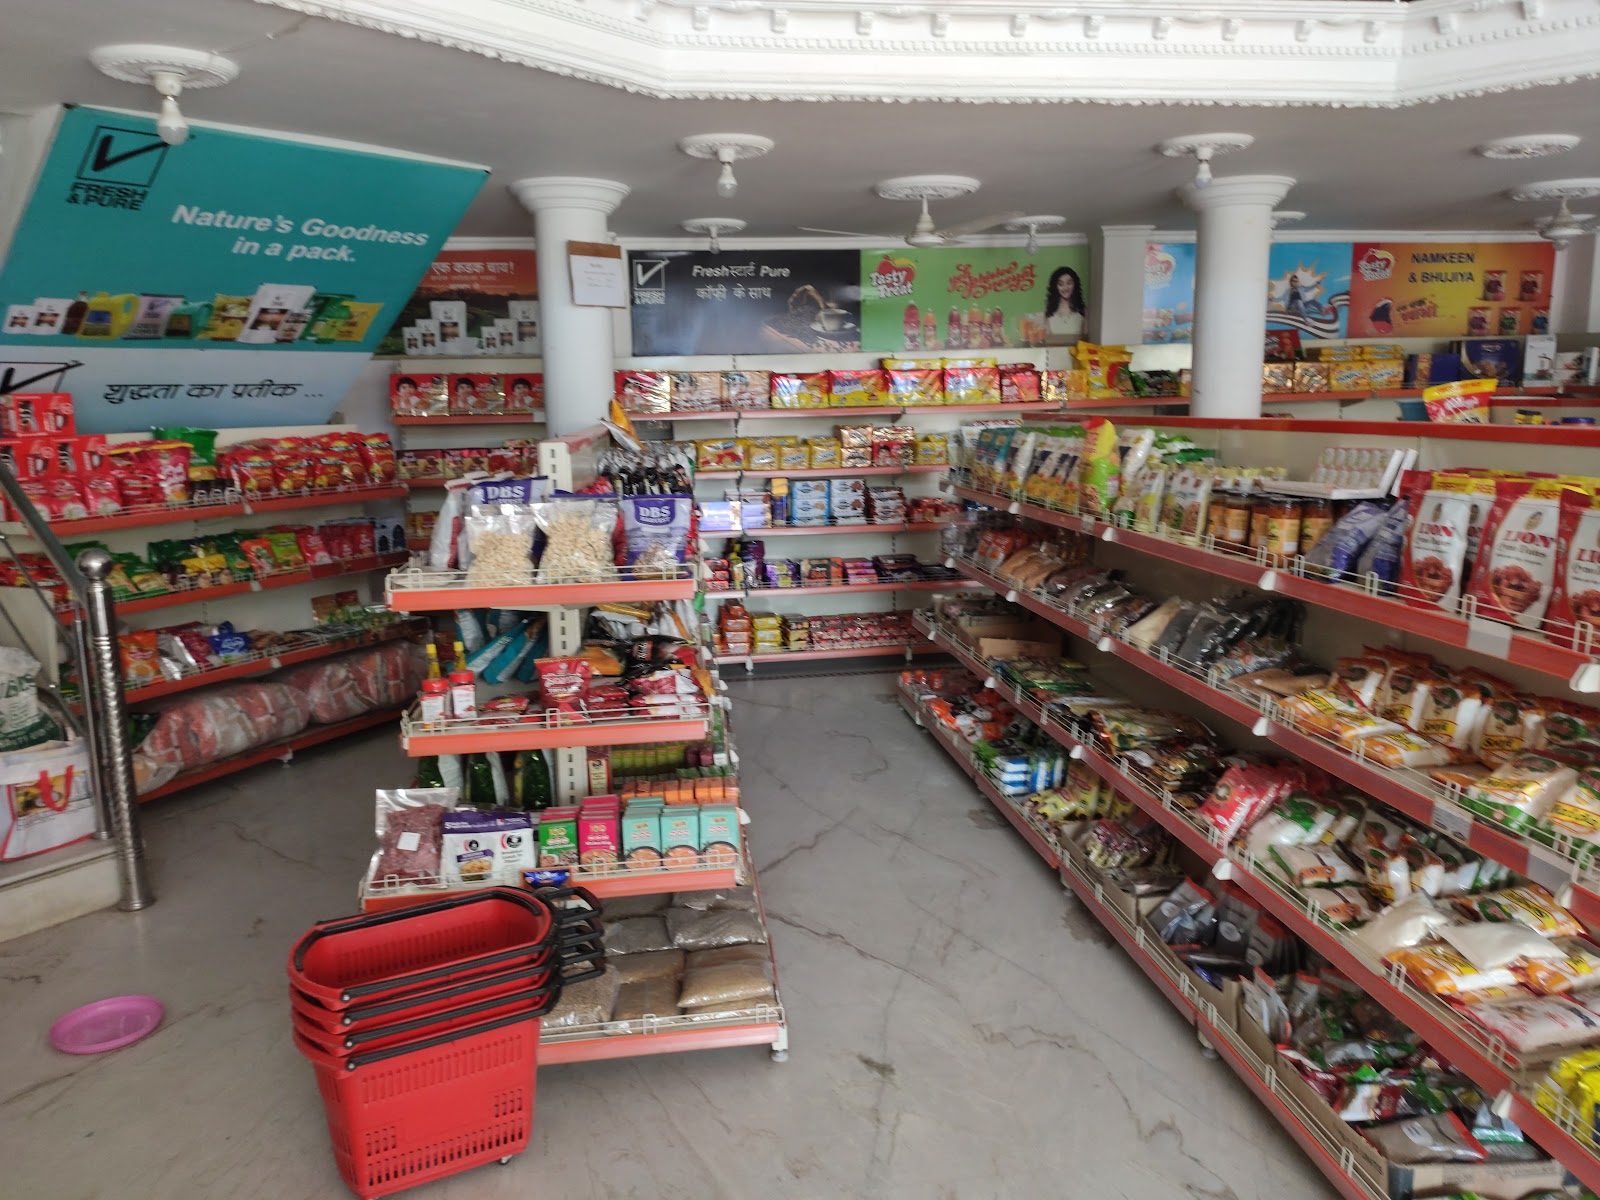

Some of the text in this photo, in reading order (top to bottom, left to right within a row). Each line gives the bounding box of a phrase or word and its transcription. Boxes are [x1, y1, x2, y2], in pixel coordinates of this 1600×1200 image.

[70, 182, 149, 202] FRESH
[82, 194, 143, 212] PURE
[171, 204, 430, 246] Nature's Goodness
[231, 235, 356, 262] in a pack.
[1410, 252, 1475, 264] NAMKEEN
[759, 264, 792, 278] Pure
[869, 269, 908, 287] Tasty
[1407, 271, 1475, 284] & BHUJIYA
[732, 282, 747, 299] के
[747, 286, 773, 299] साथ
[877, 281, 914, 298] Treat
[103, 383, 185, 405] शुद्धता
[186, 383, 229, 400] का
[486, 485, 526, 500] DBS
[639, 505, 671, 518] DBS
[1418, 522, 1456, 537] LION
[1503, 529, 1557, 549] LION
